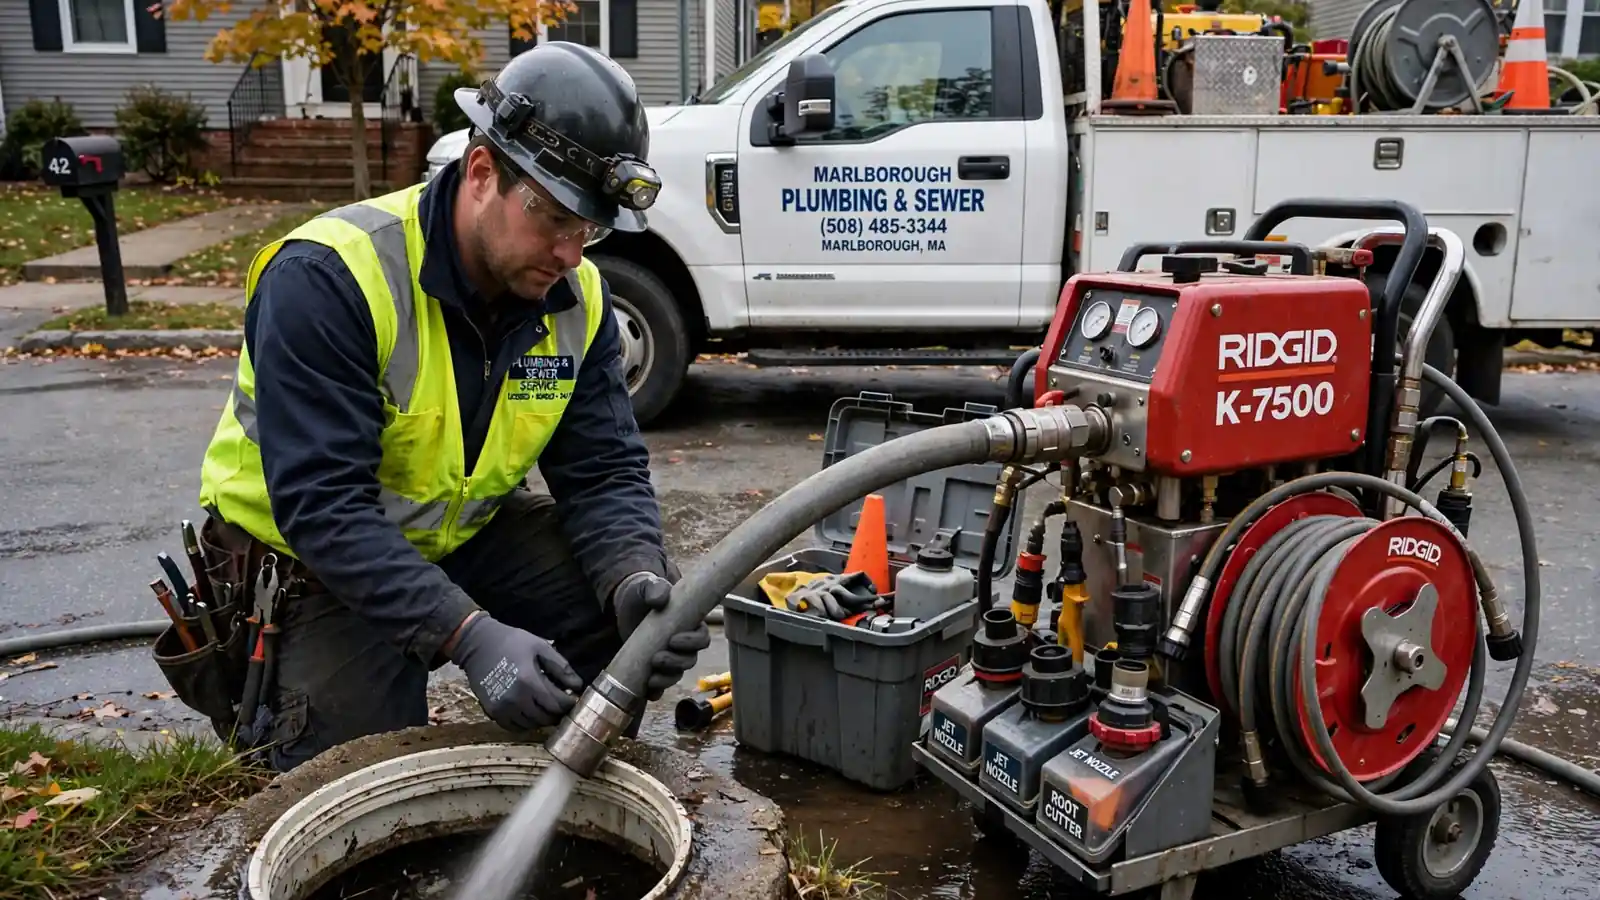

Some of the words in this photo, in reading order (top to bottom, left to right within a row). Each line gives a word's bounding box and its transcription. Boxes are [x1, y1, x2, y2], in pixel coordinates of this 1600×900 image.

[48, 157, 71, 174] 42
[813, 166, 951, 183] MARLBOROUGH
[782, 188, 887, 212] PLUMBING
[893, 188, 908, 212] &
[914, 188, 985, 212] SEWER
[820, 217, 863, 238] (508)
[868, 218, 947, 234] 485-3344
[821, 239, 924, 254] MARLBOROUGH,
[927, 240, 946, 251] MA
[1217, 328, 1337, 371] RIDGID
[1215, 381, 1335, 426] K-7500
[1387, 536, 1441, 565] RIDGID
[941, 718, 956, 735] JET
[933, 727, 965, 757] NOZZLE
[993, 752, 1009, 769] JET
[1068, 748, 1089, 761] JET
[1083, 755, 1121, 780] NOZZLE
[985, 761, 1018, 793] NOZZLE
[1051, 789, 1080, 820] ROOT
[1045, 803, 1083, 840] CUTTER
